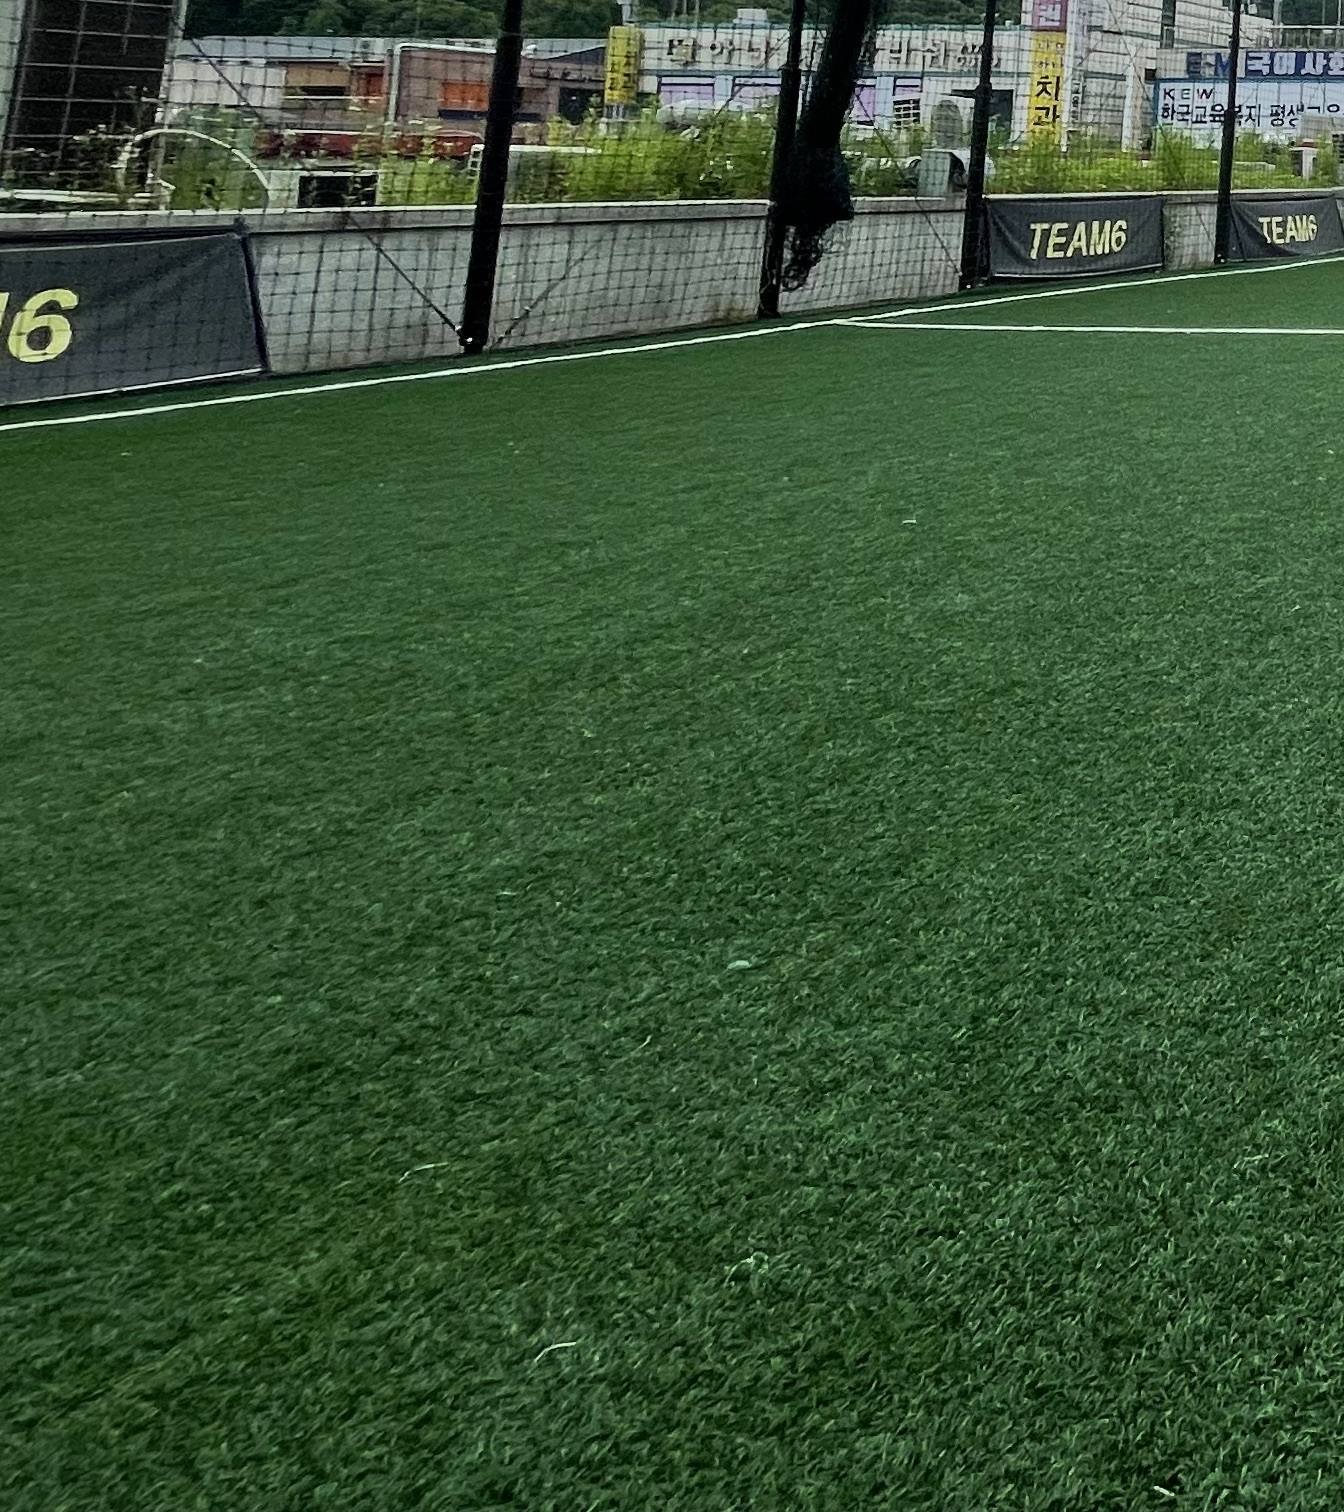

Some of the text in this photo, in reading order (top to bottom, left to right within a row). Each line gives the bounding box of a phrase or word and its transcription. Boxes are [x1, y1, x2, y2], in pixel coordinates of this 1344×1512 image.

[1033, 75, 1062, 126] 치과
[1028, 219, 1128, 261] TEAM6
[1258, 213, 1319, 245] TEAM6
